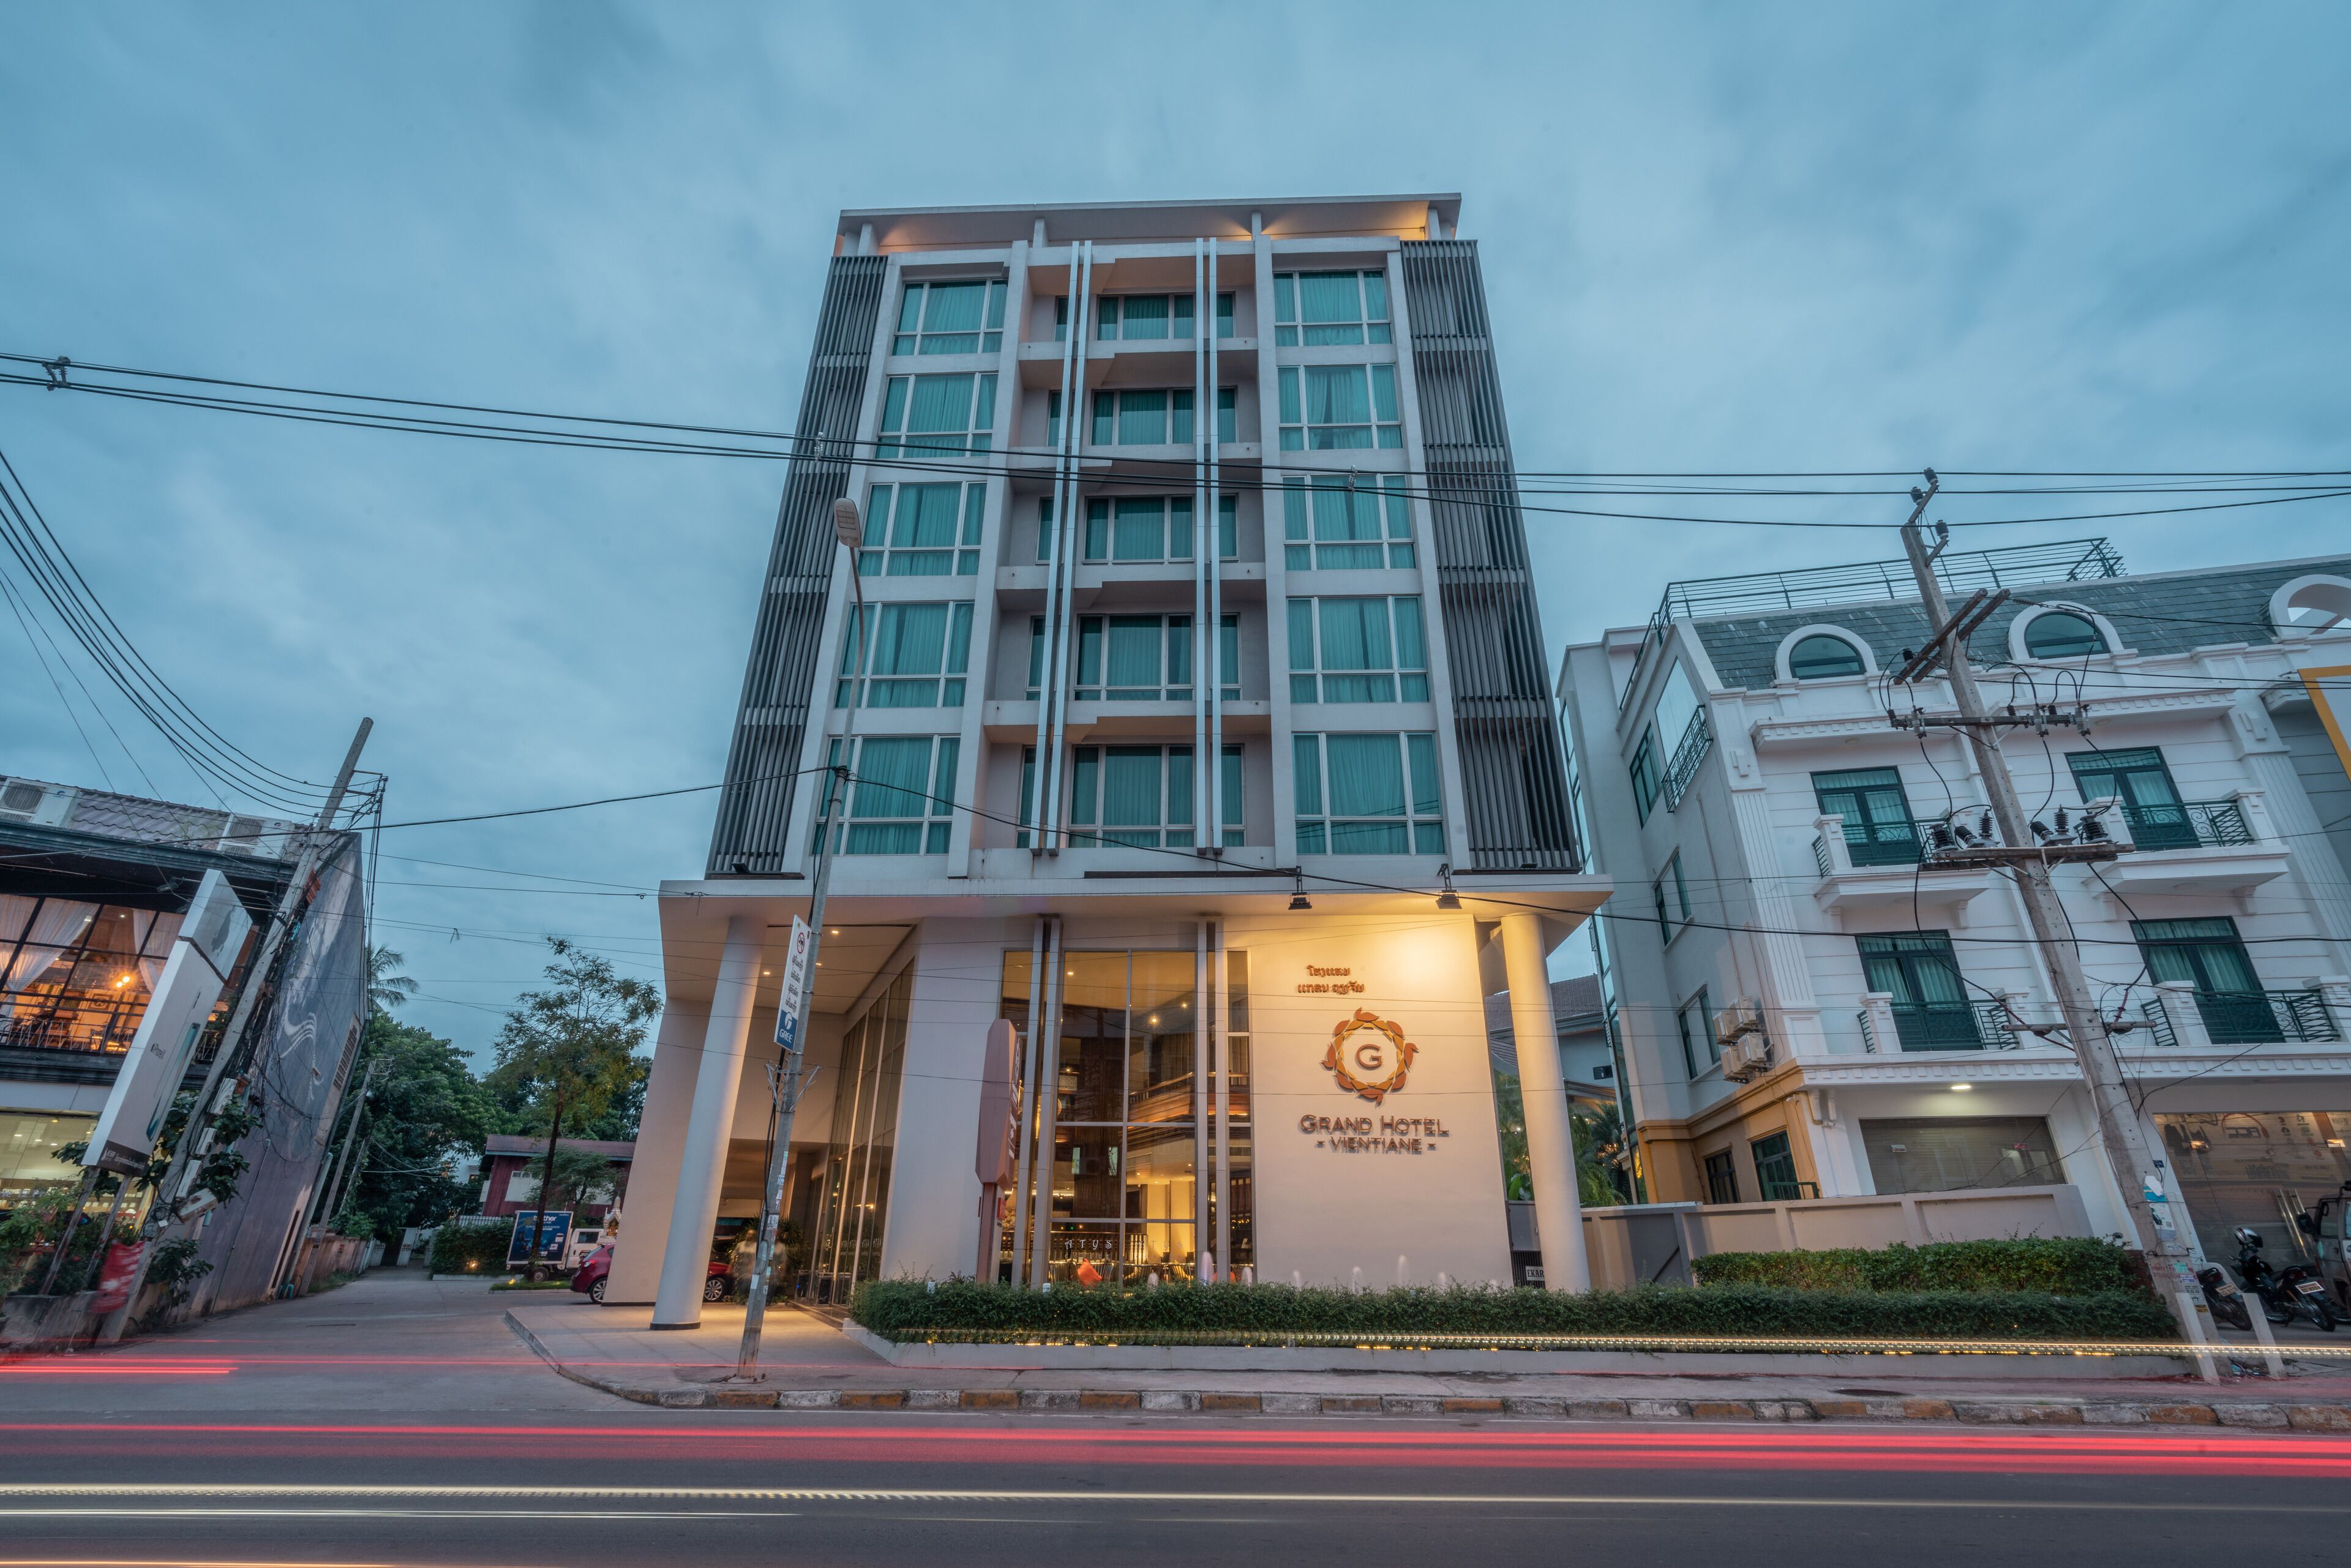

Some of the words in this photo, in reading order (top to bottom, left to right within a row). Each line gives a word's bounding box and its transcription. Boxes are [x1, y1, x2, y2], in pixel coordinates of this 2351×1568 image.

[1307, 964, 1351, 977] ໂຮງແຮມ
[779, 1029, 793, 1043] GREE
[1355, 1044, 1382, 1068] G
[1300, 1114, 1373, 1133] GRAND
[1381, 1115, 1450, 1135] HOTEL
[1330, 1136, 1423, 1152] VIENTIANE
[1065, 1239, 1112, 1250] ATYS
